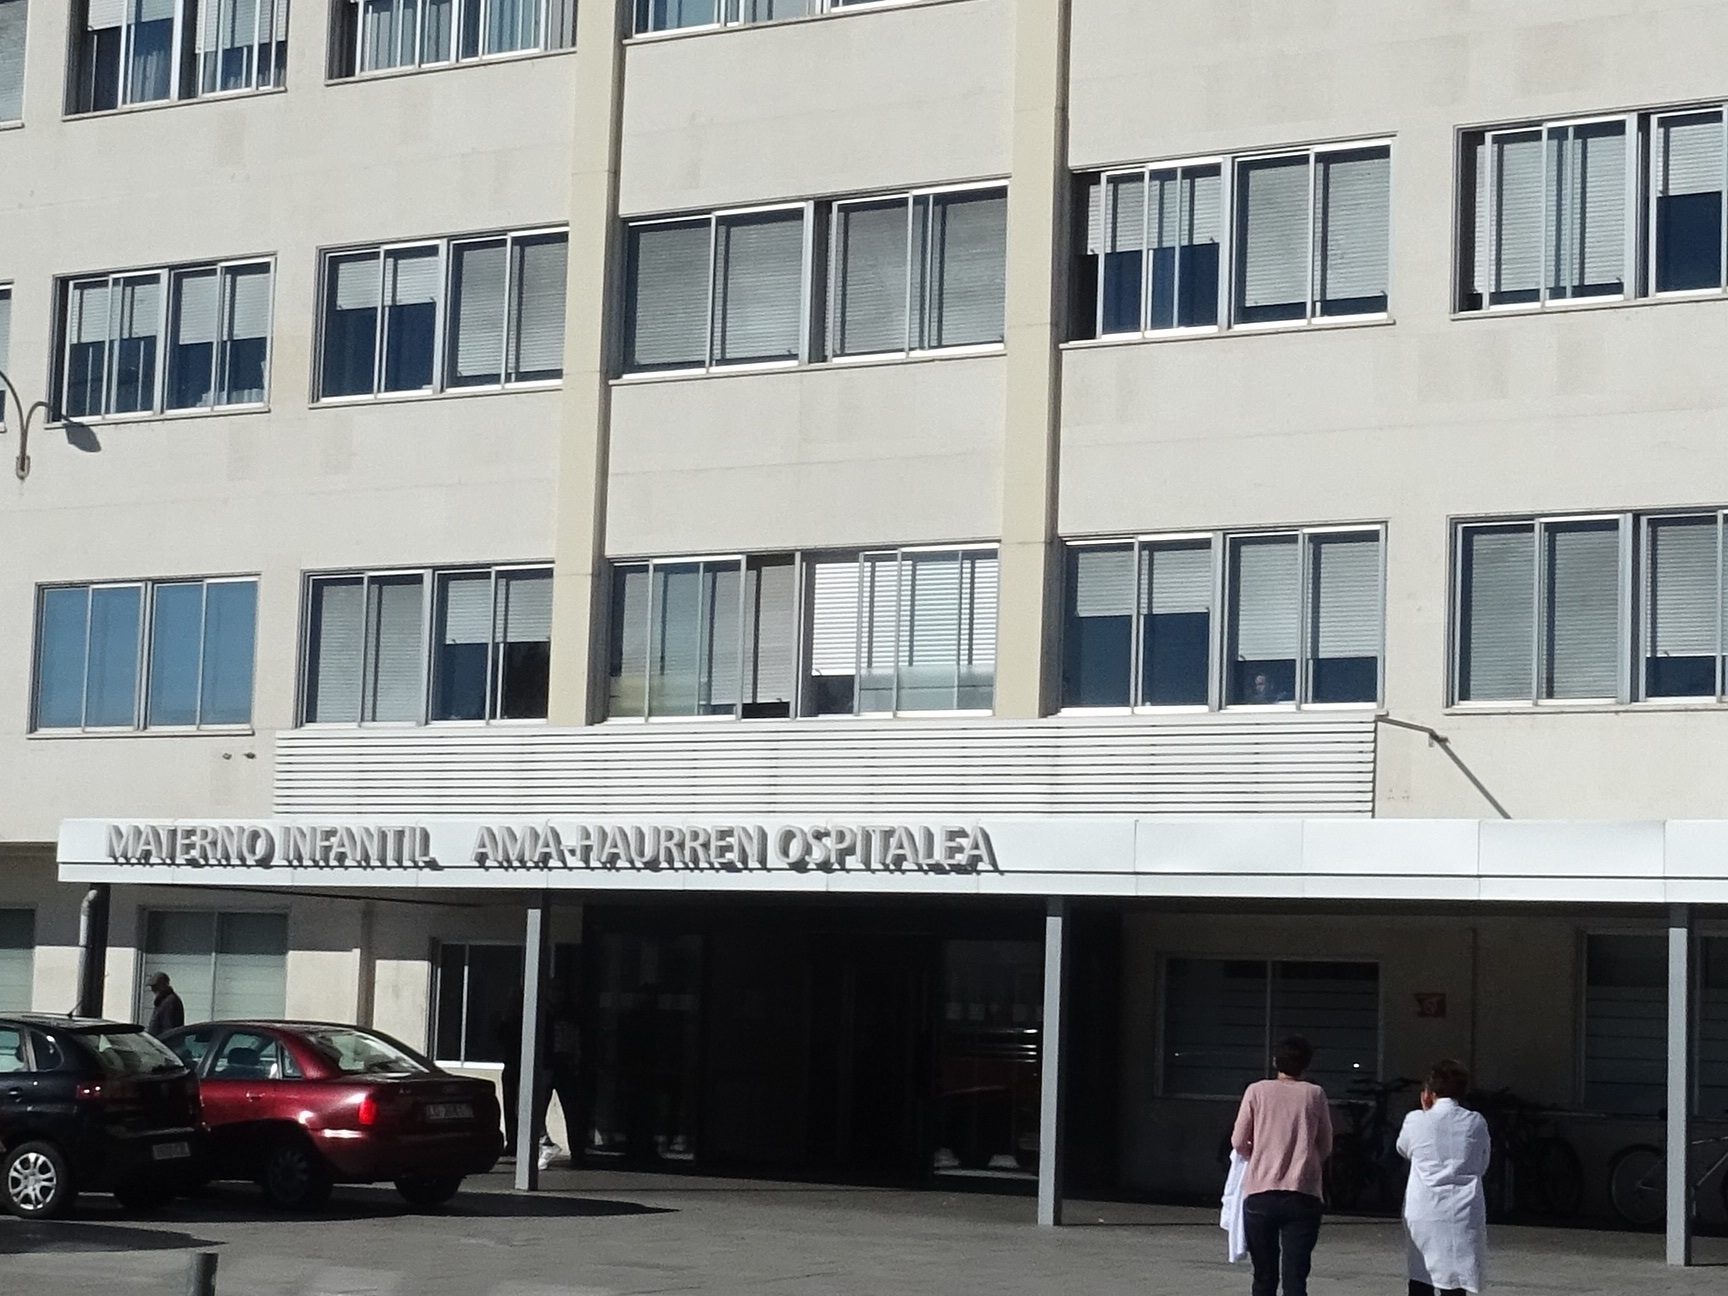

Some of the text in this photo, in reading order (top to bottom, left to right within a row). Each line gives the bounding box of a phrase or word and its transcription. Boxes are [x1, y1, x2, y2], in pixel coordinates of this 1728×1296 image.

[105, 823, 995, 867] MATERNO INFANTIL AMA-HAURREN OSPITALEA
